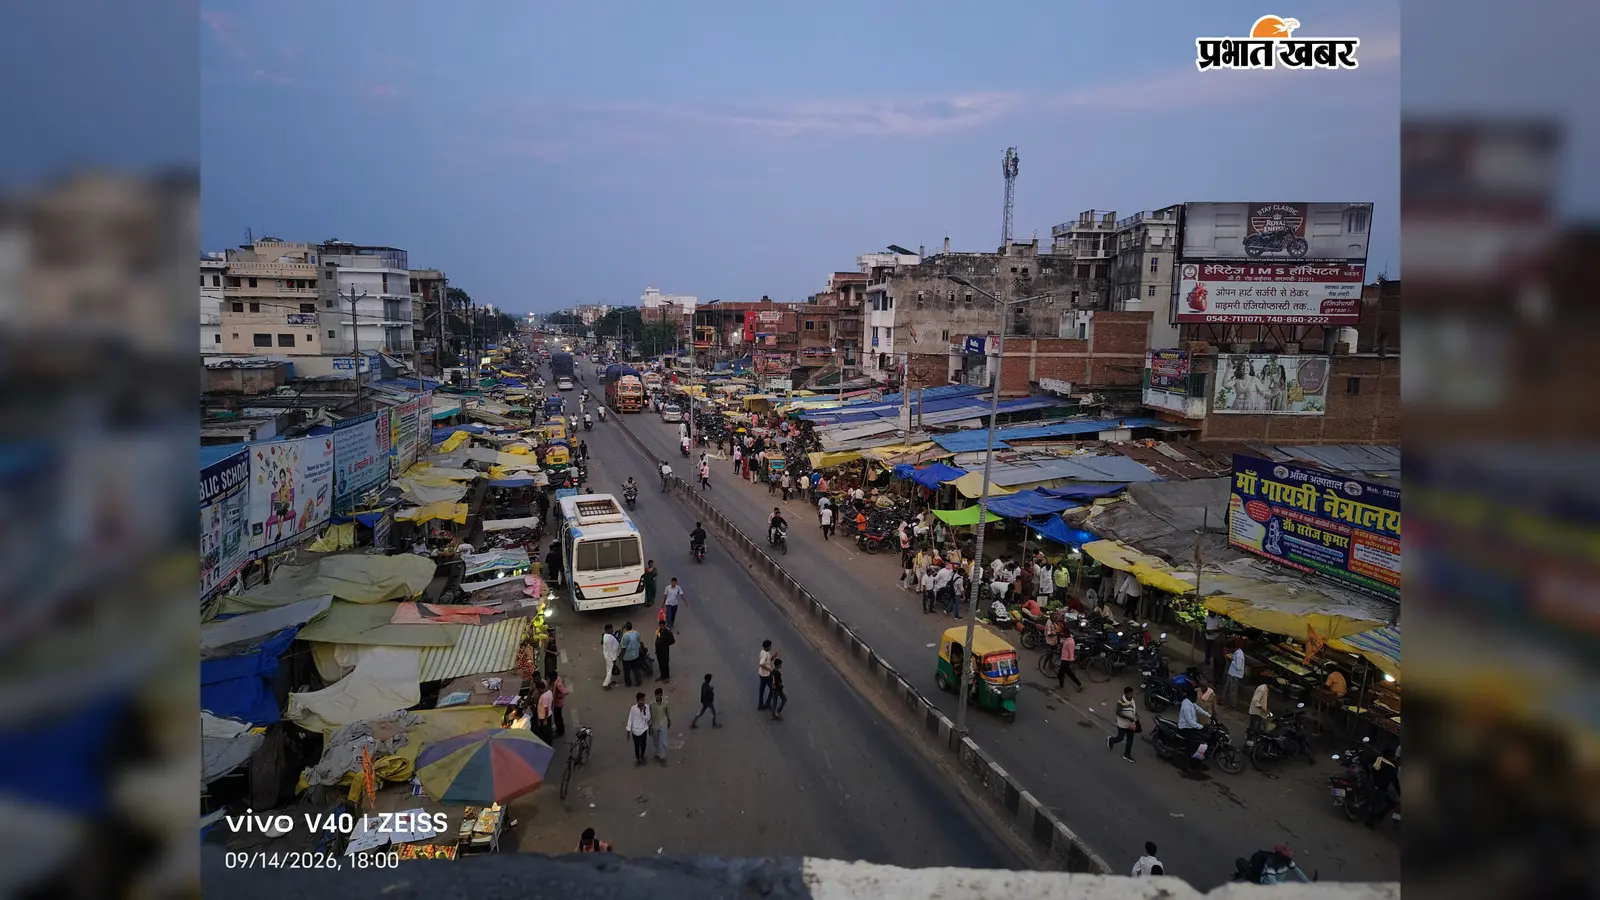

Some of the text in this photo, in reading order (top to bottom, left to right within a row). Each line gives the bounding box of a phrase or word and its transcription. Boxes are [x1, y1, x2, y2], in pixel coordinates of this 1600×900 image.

[1256, 204, 1299, 216] STAY CLASSIC
[1204, 264, 1246, 275] हेरिटेज
[1289, 265, 1340, 276] हॉस्पिटल
[1216, 286, 1310, 297] ओपन हार्ट सर्जरी से लेकर
[1215, 300, 1240, 311] प्राइमरी
[1243, 300, 1290, 310] एंजियोप्लास्टी
[220, 460, 248, 490] SCHOOL
[1310, 475, 1343, 490] अस्पताल
[1261, 478, 1320, 512] गायत्री
[1323, 488, 1400, 535] नेत्रालय
[1297, 523, 1321, 540] सरोज
[1323, 531, 1349, 548] कुमार
